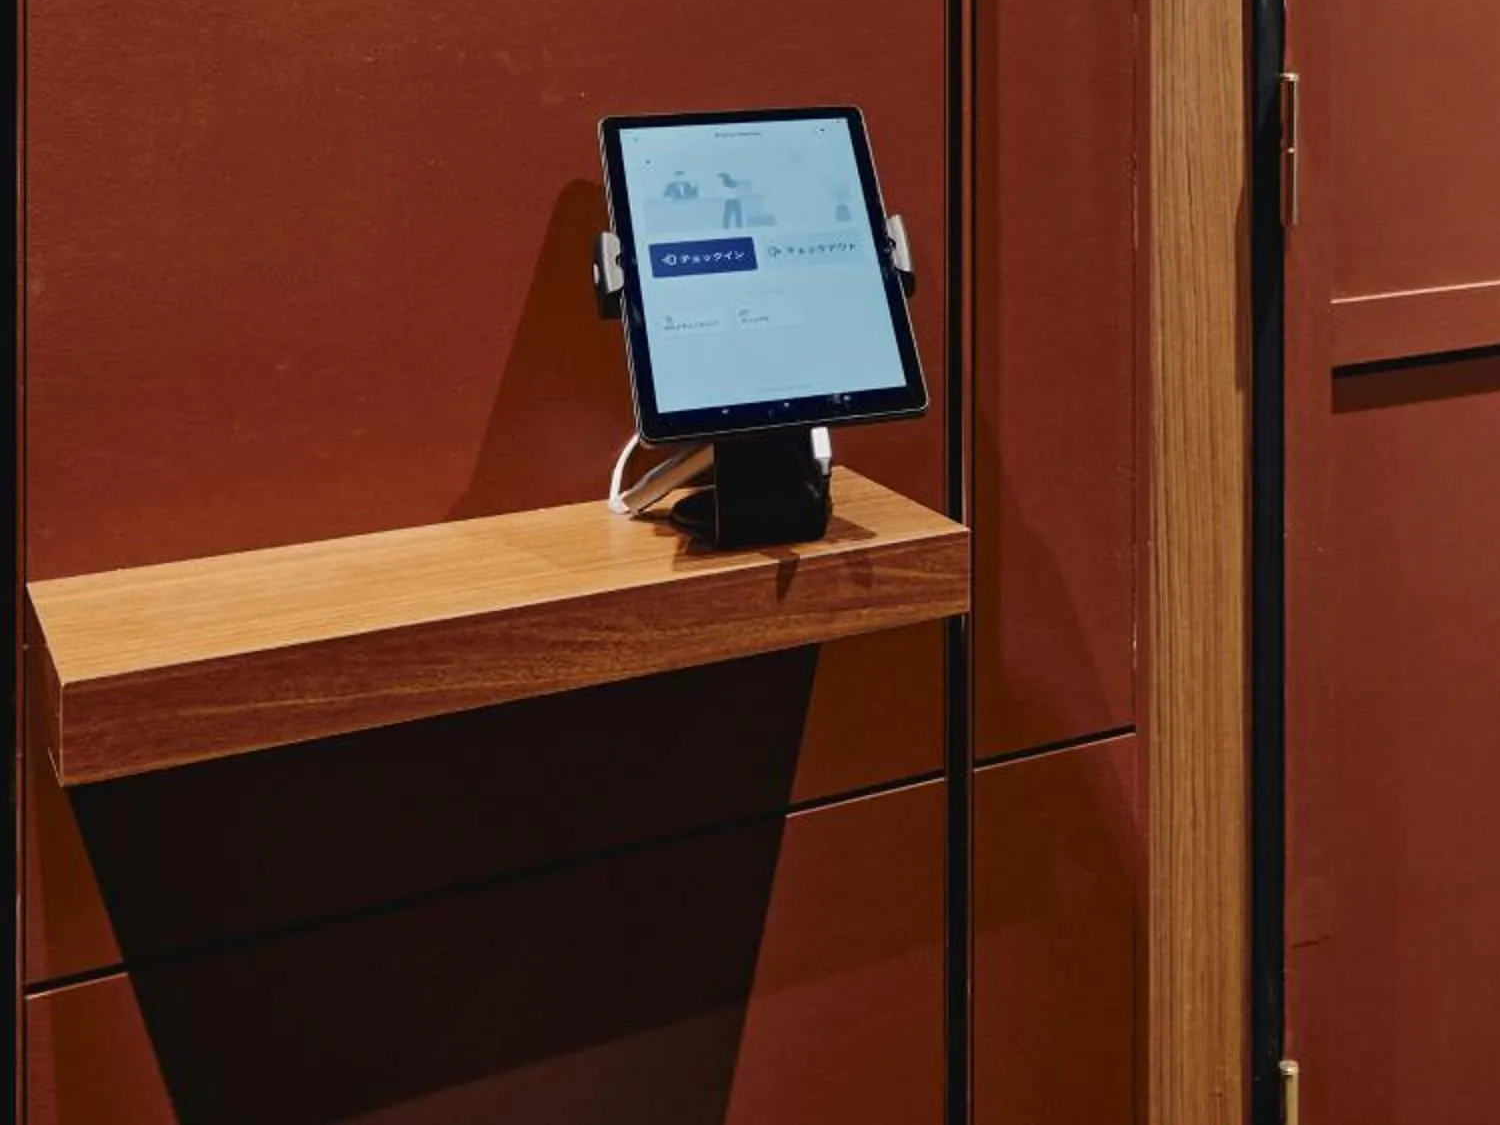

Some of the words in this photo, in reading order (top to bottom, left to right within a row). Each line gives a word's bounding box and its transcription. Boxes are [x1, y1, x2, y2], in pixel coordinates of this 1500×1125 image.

[680, 250, 746, 265] チェックイン
